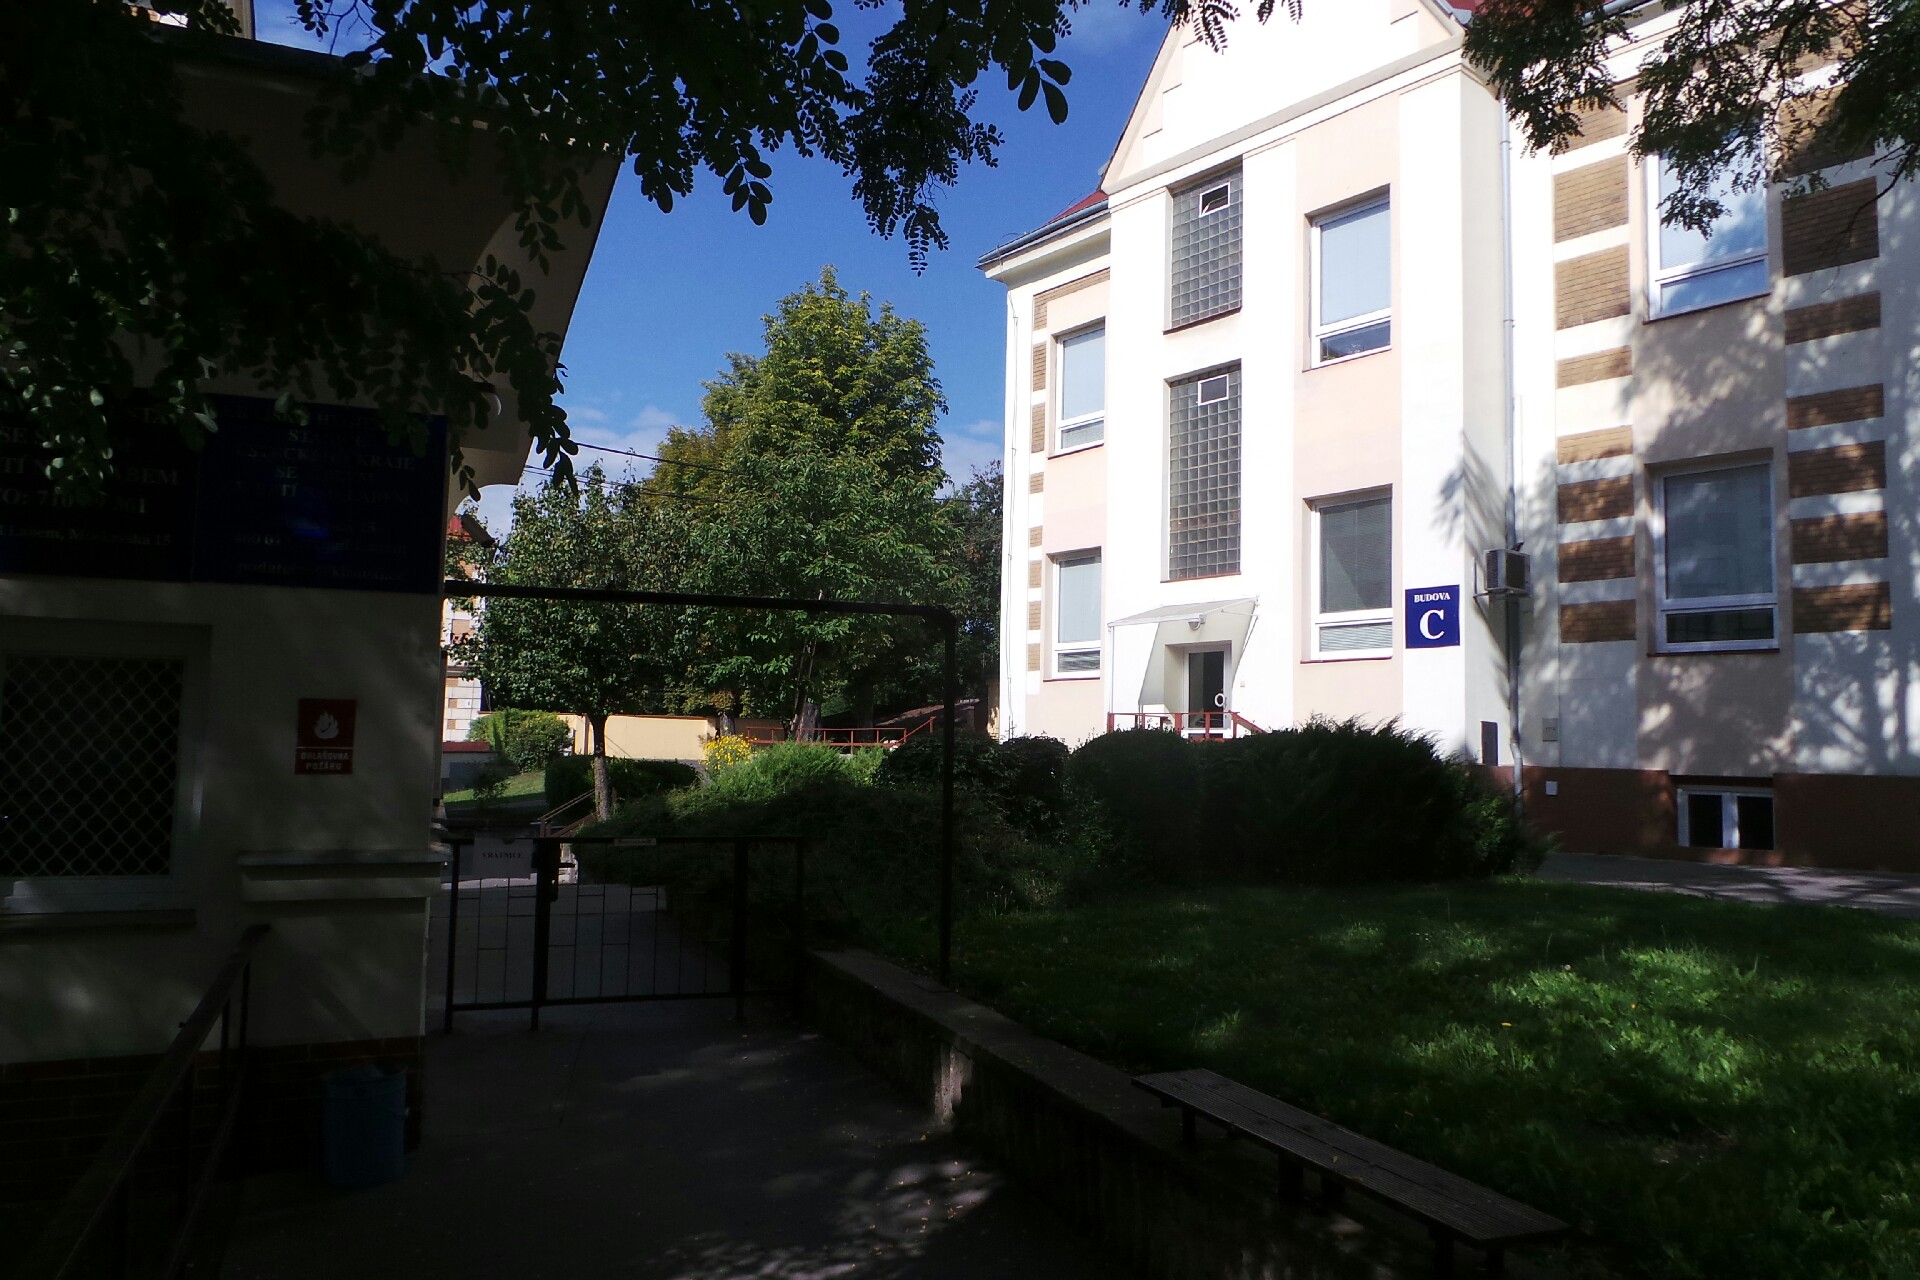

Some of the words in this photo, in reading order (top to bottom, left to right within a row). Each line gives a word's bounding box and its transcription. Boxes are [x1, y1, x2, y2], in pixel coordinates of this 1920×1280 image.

[356, 453, 416, 472] KRAJE
[274, 465, 299, 481] SE
[1413, 592, 1451, 603] BUDOVA
[1419, 609, 1445, 640] C
